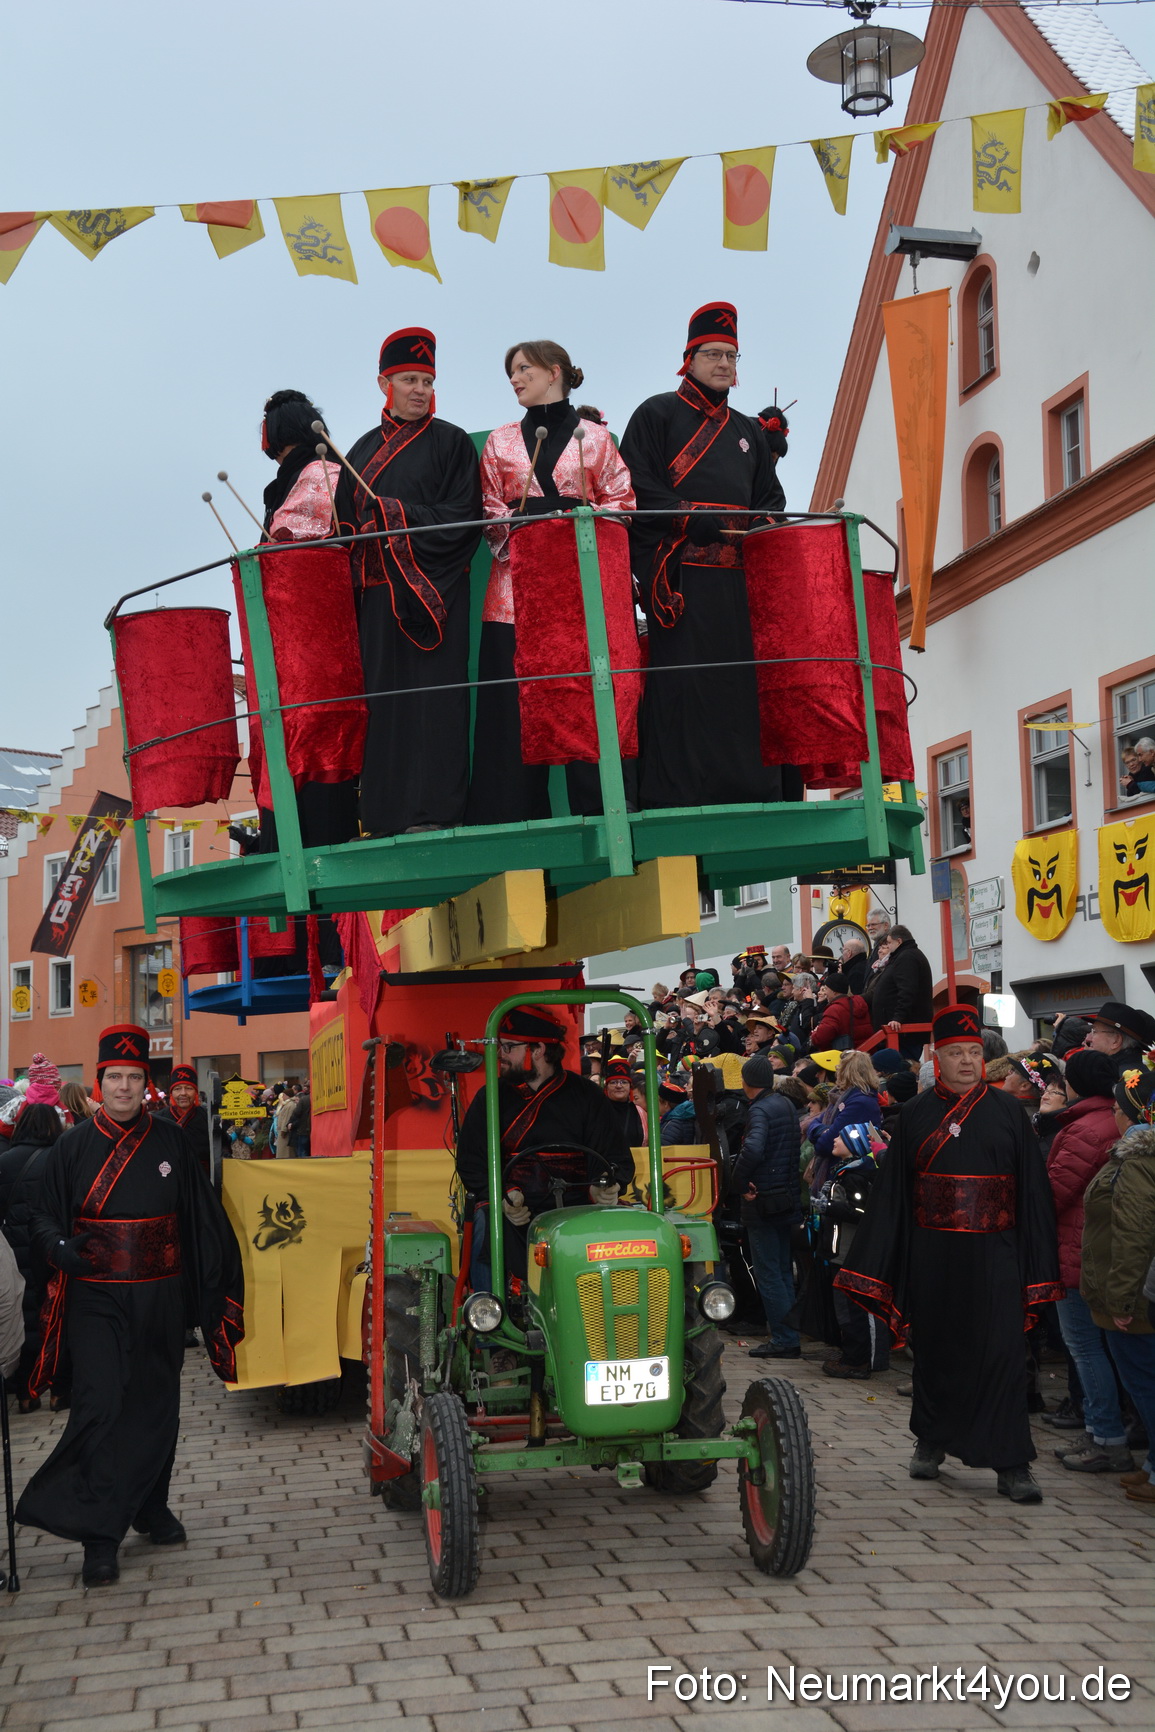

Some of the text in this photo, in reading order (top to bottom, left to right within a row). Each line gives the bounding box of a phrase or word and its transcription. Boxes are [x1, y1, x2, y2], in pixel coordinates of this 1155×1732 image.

[149, 1037, 173, 1051] TZ
[590, 1242, 655, 1259] Holder
[606, 1364, 631, 1381] NM
[601, 1384, 625, 1401] EP
